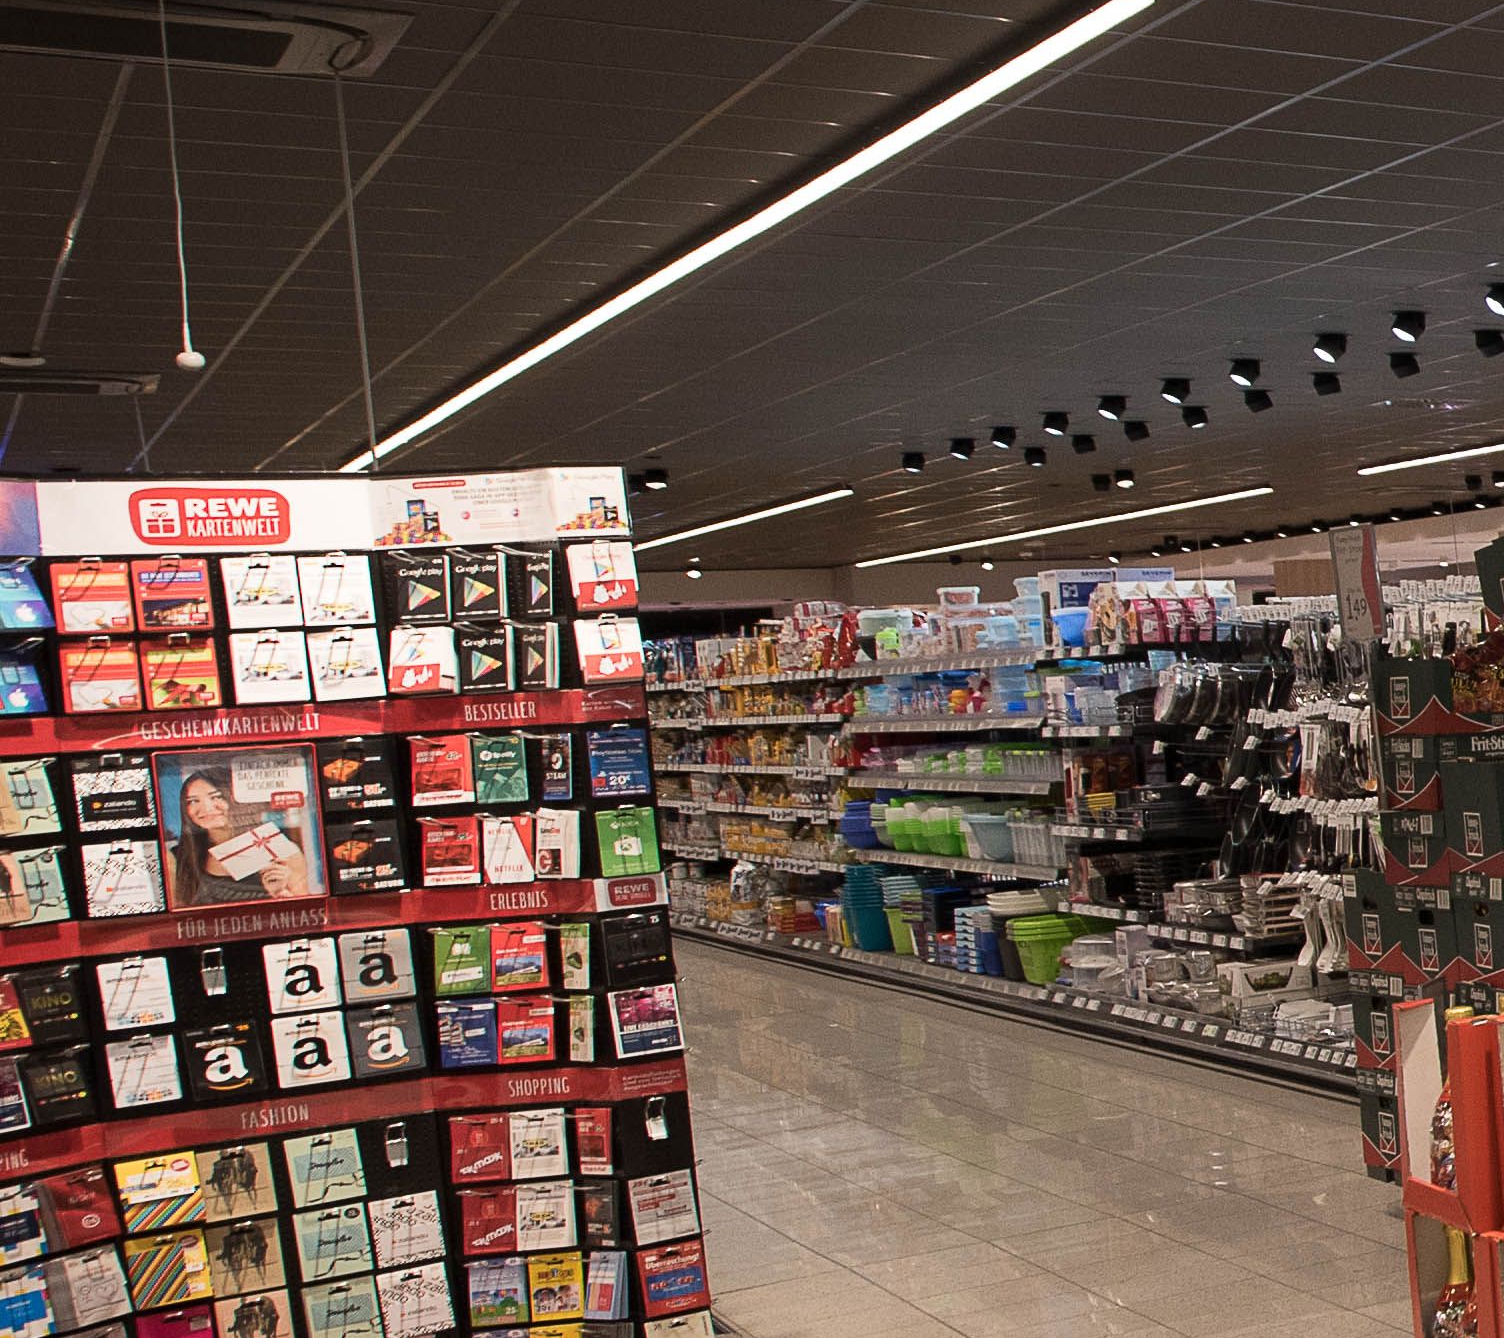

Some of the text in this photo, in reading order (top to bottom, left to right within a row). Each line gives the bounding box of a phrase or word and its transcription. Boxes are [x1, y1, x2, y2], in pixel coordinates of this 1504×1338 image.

[185, 497, 280, 518] REWE
[186, 518, 281, 538] KARTENWELT
[465, 701, 537, 722] BESTSELLER
[140, 712, 321, 741] GESCHENKKARTENWELT
[490, 890, 549, 911] ERLEBNIS
[269, 908, 328, 930] ANLASS
[508, 1077, 570, 1099] SHOPPING
[241, 1106, 309, 1130] FASHION
